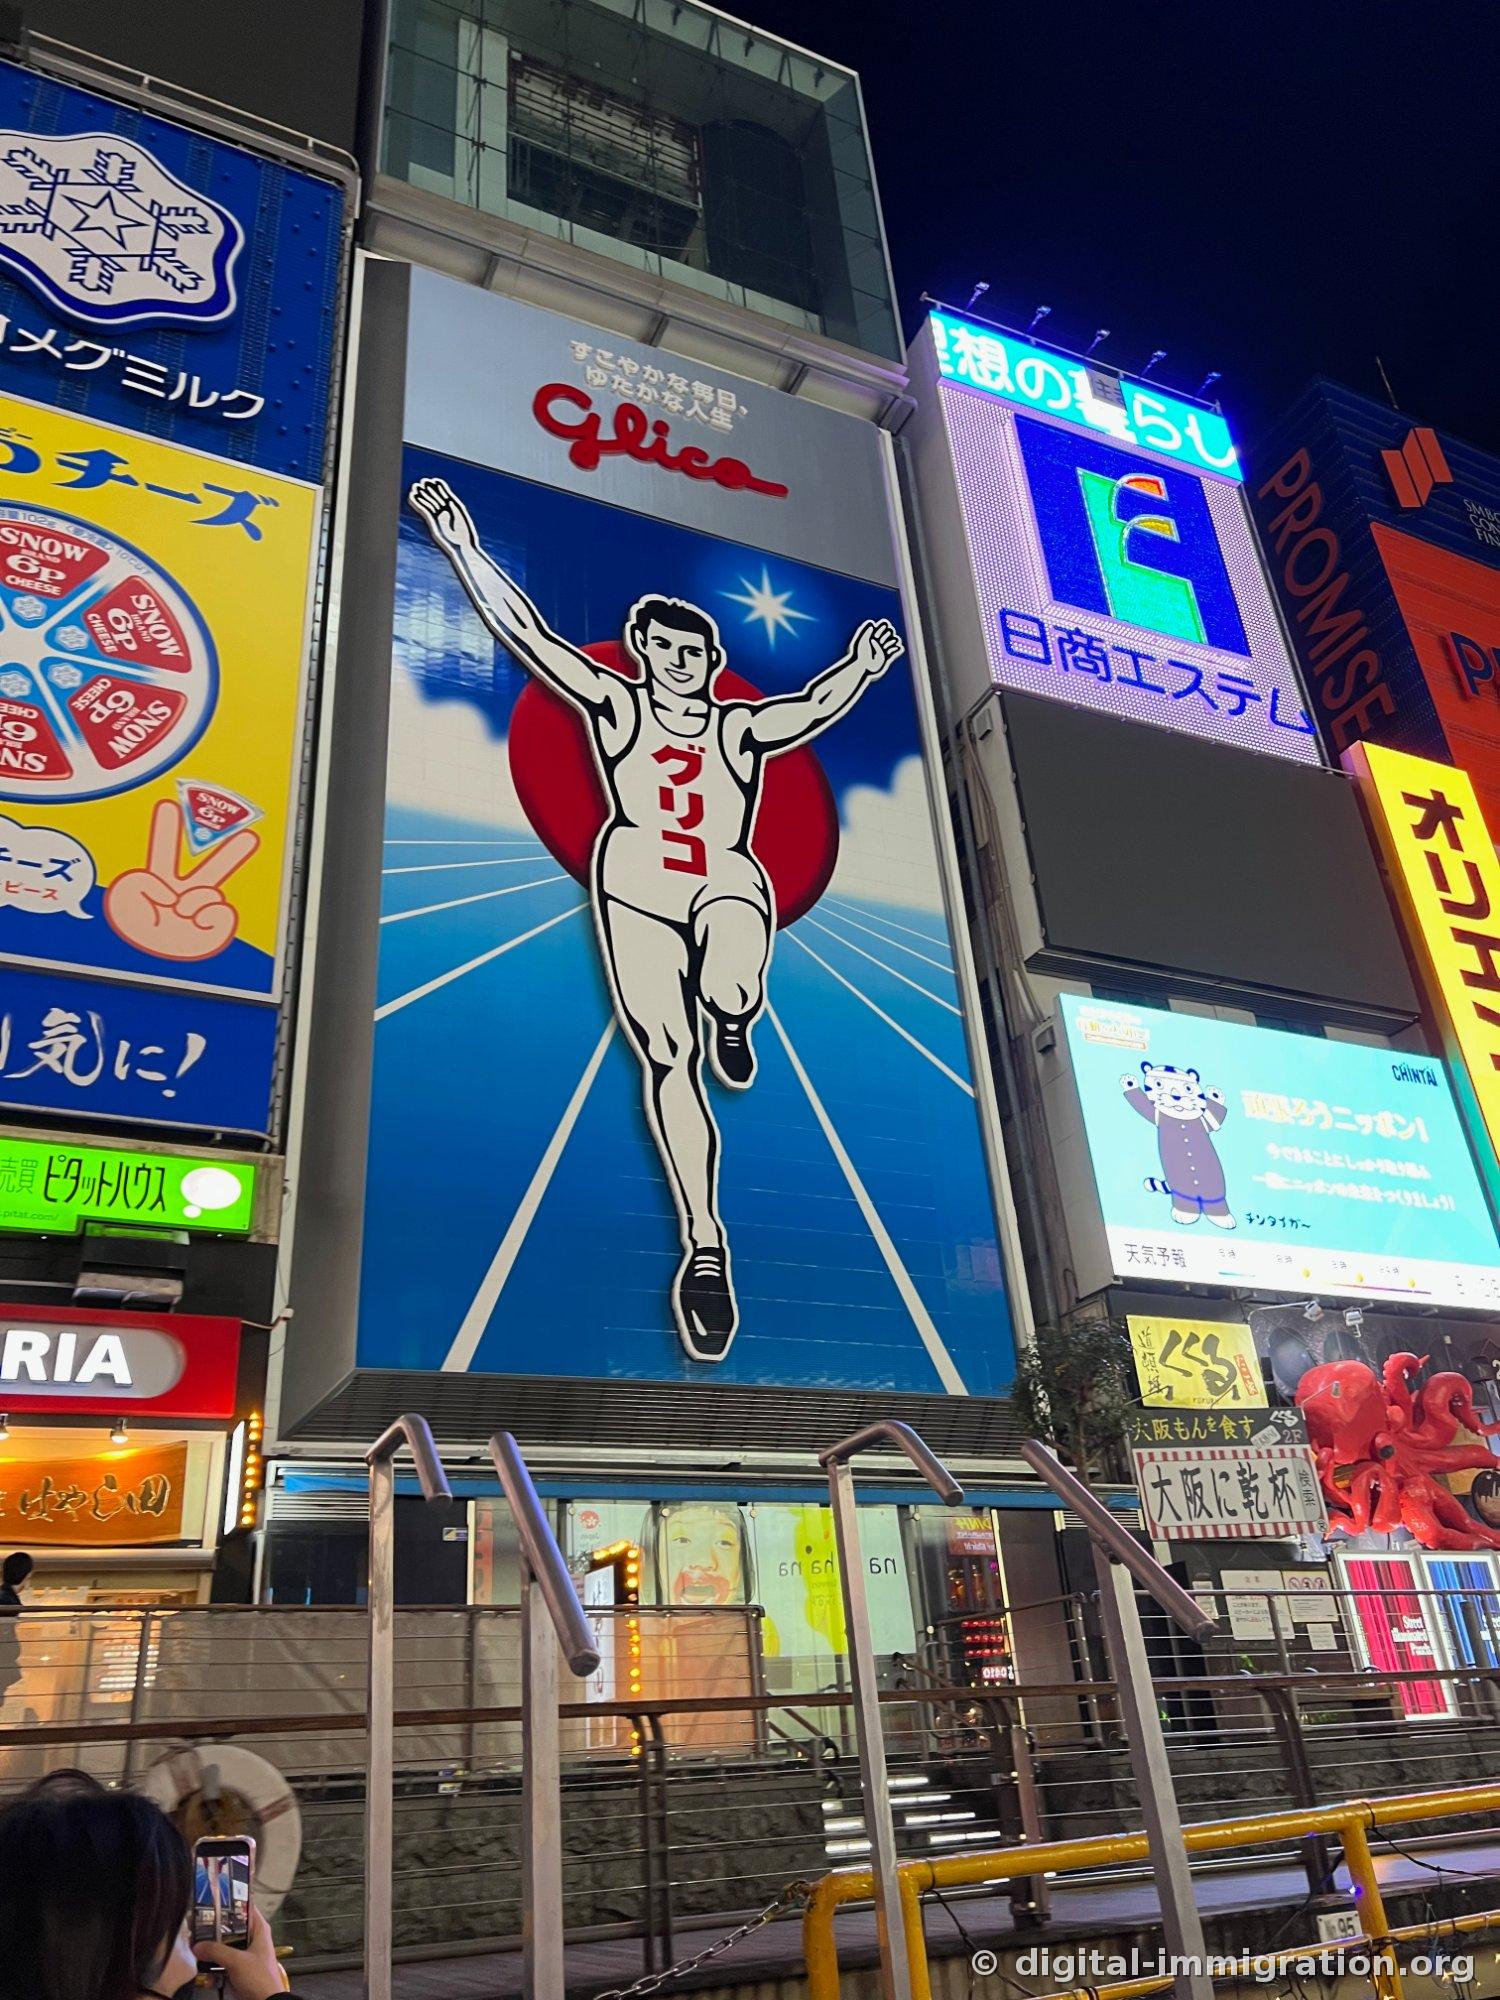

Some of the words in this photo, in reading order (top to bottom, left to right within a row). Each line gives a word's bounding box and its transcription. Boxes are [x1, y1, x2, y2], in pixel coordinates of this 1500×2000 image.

[569, 340, 749, 418] すこやかな毎日、
[585, 365, 735, 433] ゆたかな人生
[532, 383, 789, 499] Glico
[0, 527, 90, 561] SNOW
[6, 555, 67, 583] 6P
[6, 575, 61, 596] CHEESE
[1257, 447, 1395, 751] PROMISE
[87, 613, 117, 653] CHEESE
[108, 608, 138, 651] 6P
[130, 594, 184, 657] SNOW
[1000, 608, 1316, 735] 日商エステム
[1449, 631, 1500, 696] P
[71, 678, 112, 711] CHEESE
[89, 690, 136, 724] 6P
[108, 700, 172, 759] SNOW
[196, 792, 241, 814] SNOW
[650, 744, 708, 877] グリコ
[5, 880, 58, 900] ピース
[0, 1007, 206, 1098] 気に!
[1392, 1062, 1438, 1086] CHINTAI
[43, 1155, 167, 1212] ピタットハウス
[1124, 1243, 1187, 1268] 天気予報
[0, 1329, 133, 1384] RIA
[1158, 1329, 1239, 1397] くくる
[1132, 1415, 1255, 1441] 大阪もんを食す
[1282, 1429, 1302, 1444] 2F
[0, 1473, 171, 1522] はやし田
[1151, 1461, 1297, 1523] 大阪に乾杯
